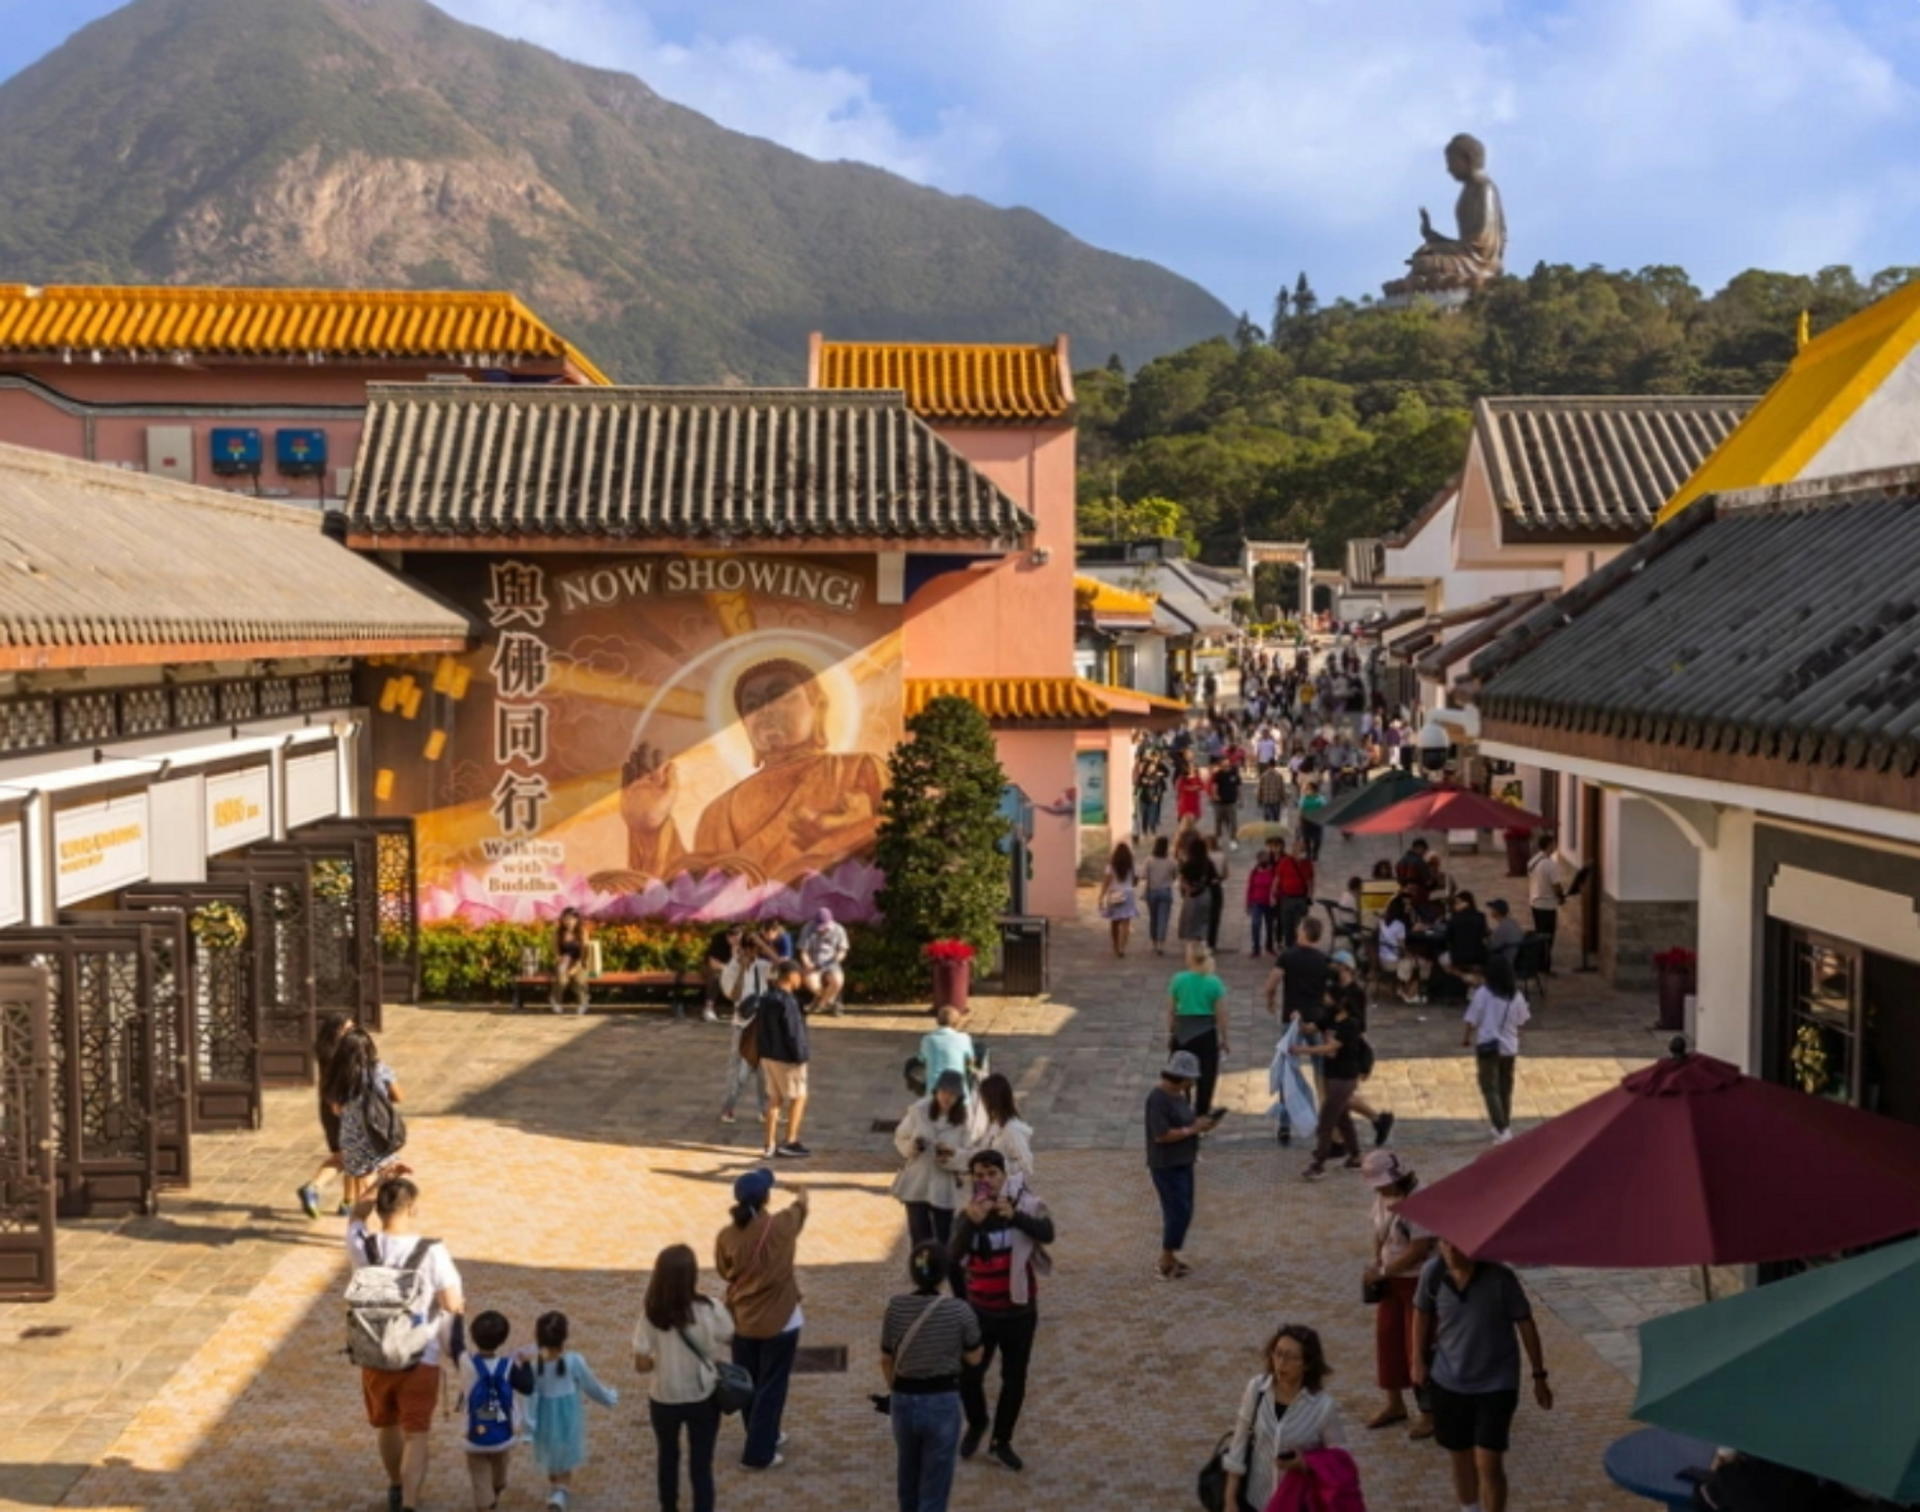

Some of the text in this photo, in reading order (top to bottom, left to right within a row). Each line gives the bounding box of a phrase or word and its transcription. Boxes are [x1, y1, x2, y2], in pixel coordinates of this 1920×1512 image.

[560, 558, 861, 610] NOW SHOWING!
[488, 564, 548, 833] 與佛同行
[483, 840, 562, 858] Walking
[502, 859, 542, 874] with
[488, 877, 558, 893] Buddha
